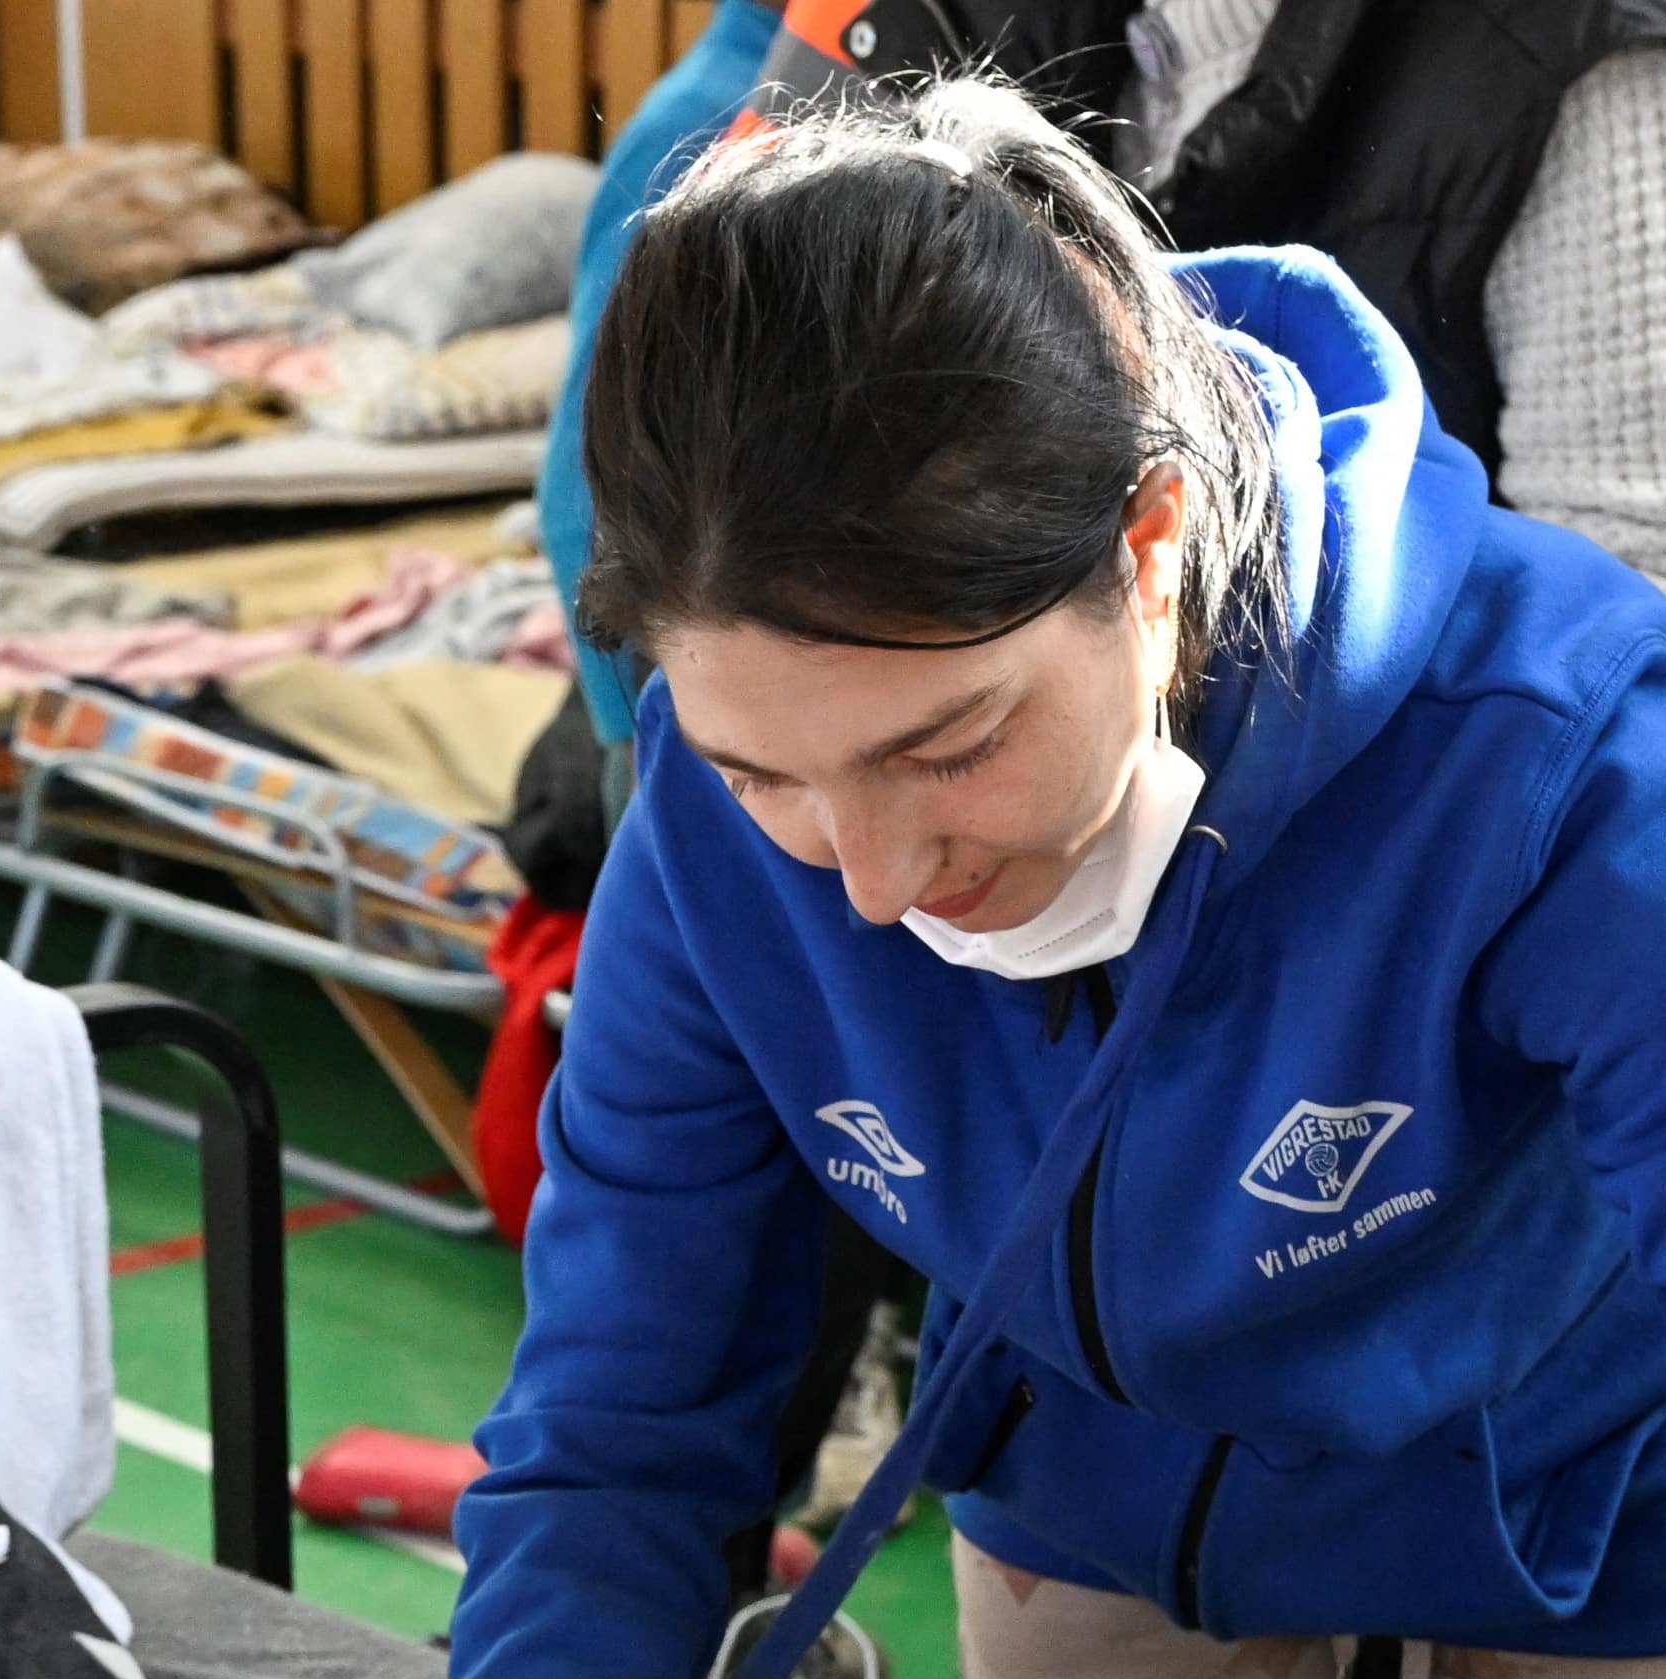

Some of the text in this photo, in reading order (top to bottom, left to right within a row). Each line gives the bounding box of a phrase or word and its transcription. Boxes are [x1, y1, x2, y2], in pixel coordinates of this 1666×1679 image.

[1261, 1115, 1372, 1183] VIGRESTAD
[1255, 1187, 1437, 1280] Vi løfter sammen
